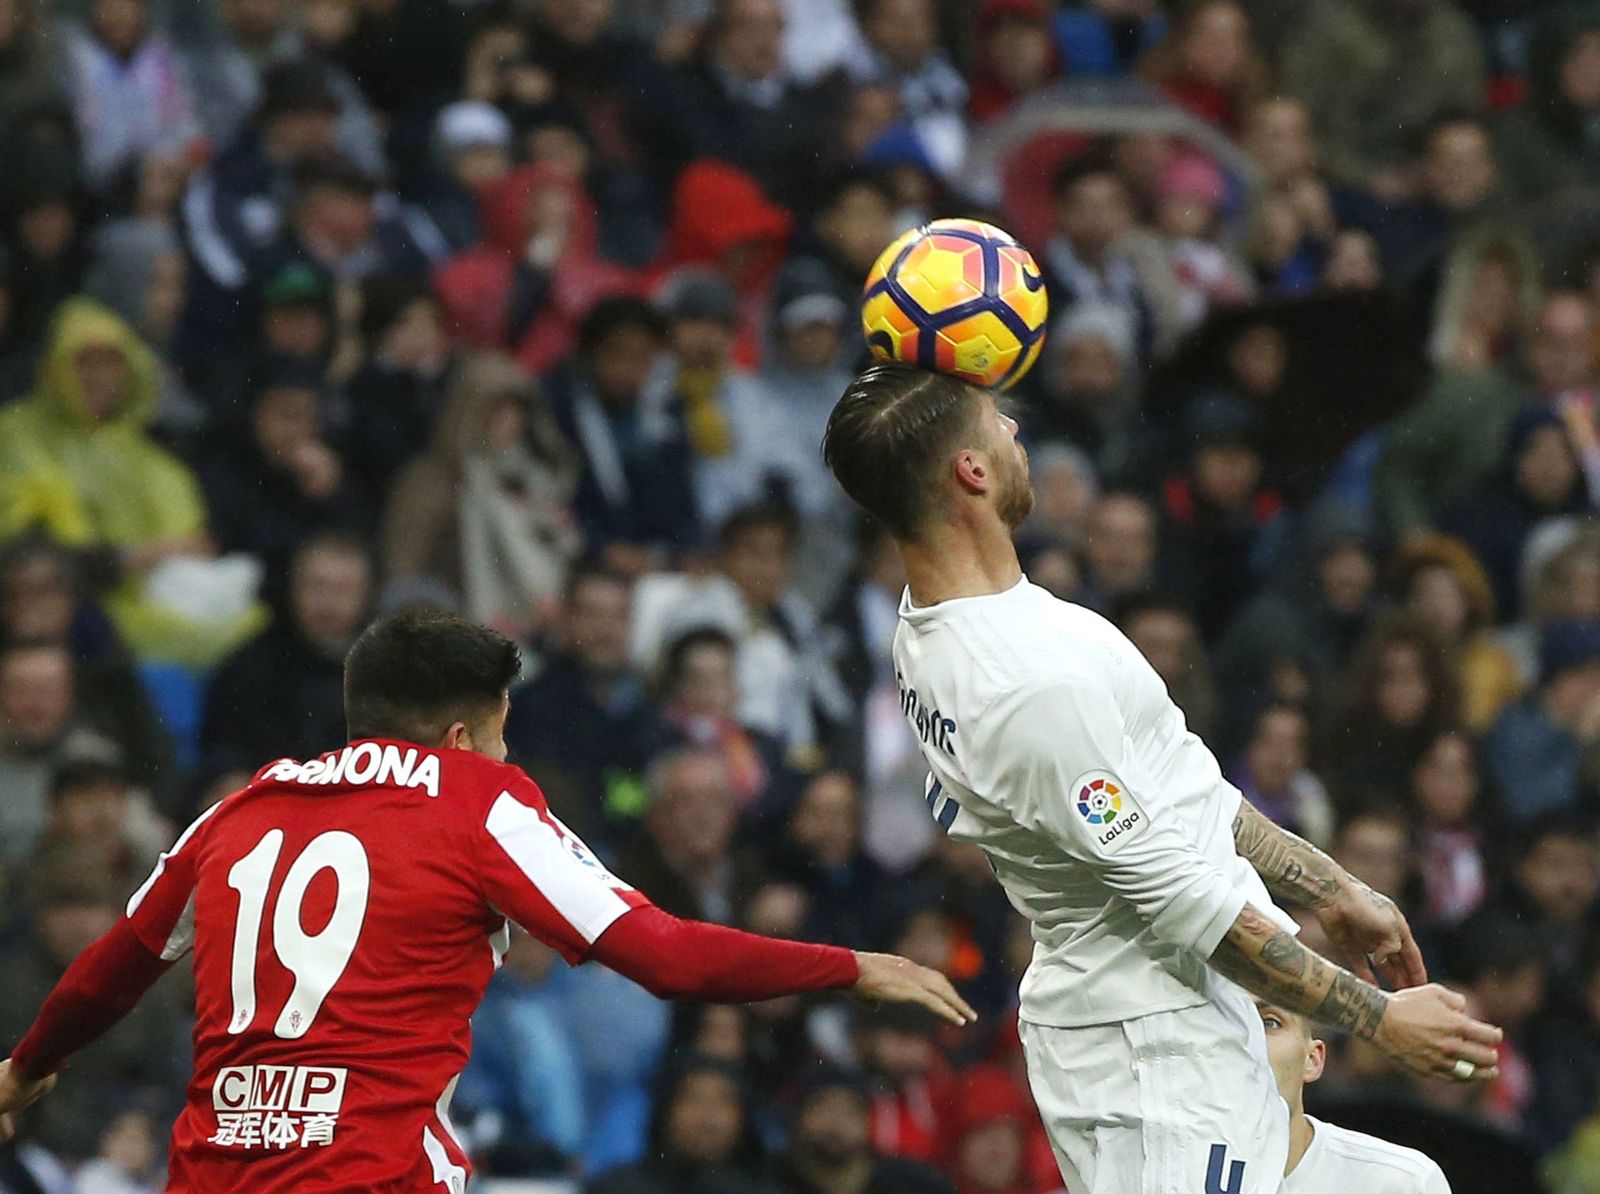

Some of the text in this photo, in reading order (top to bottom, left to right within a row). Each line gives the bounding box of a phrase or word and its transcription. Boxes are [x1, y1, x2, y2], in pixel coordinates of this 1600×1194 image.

[1098, 810, 1141, 847] LaLiga
[226, 828, 371, 1040] 19
[217, 1068, 338, 1109] CMP
